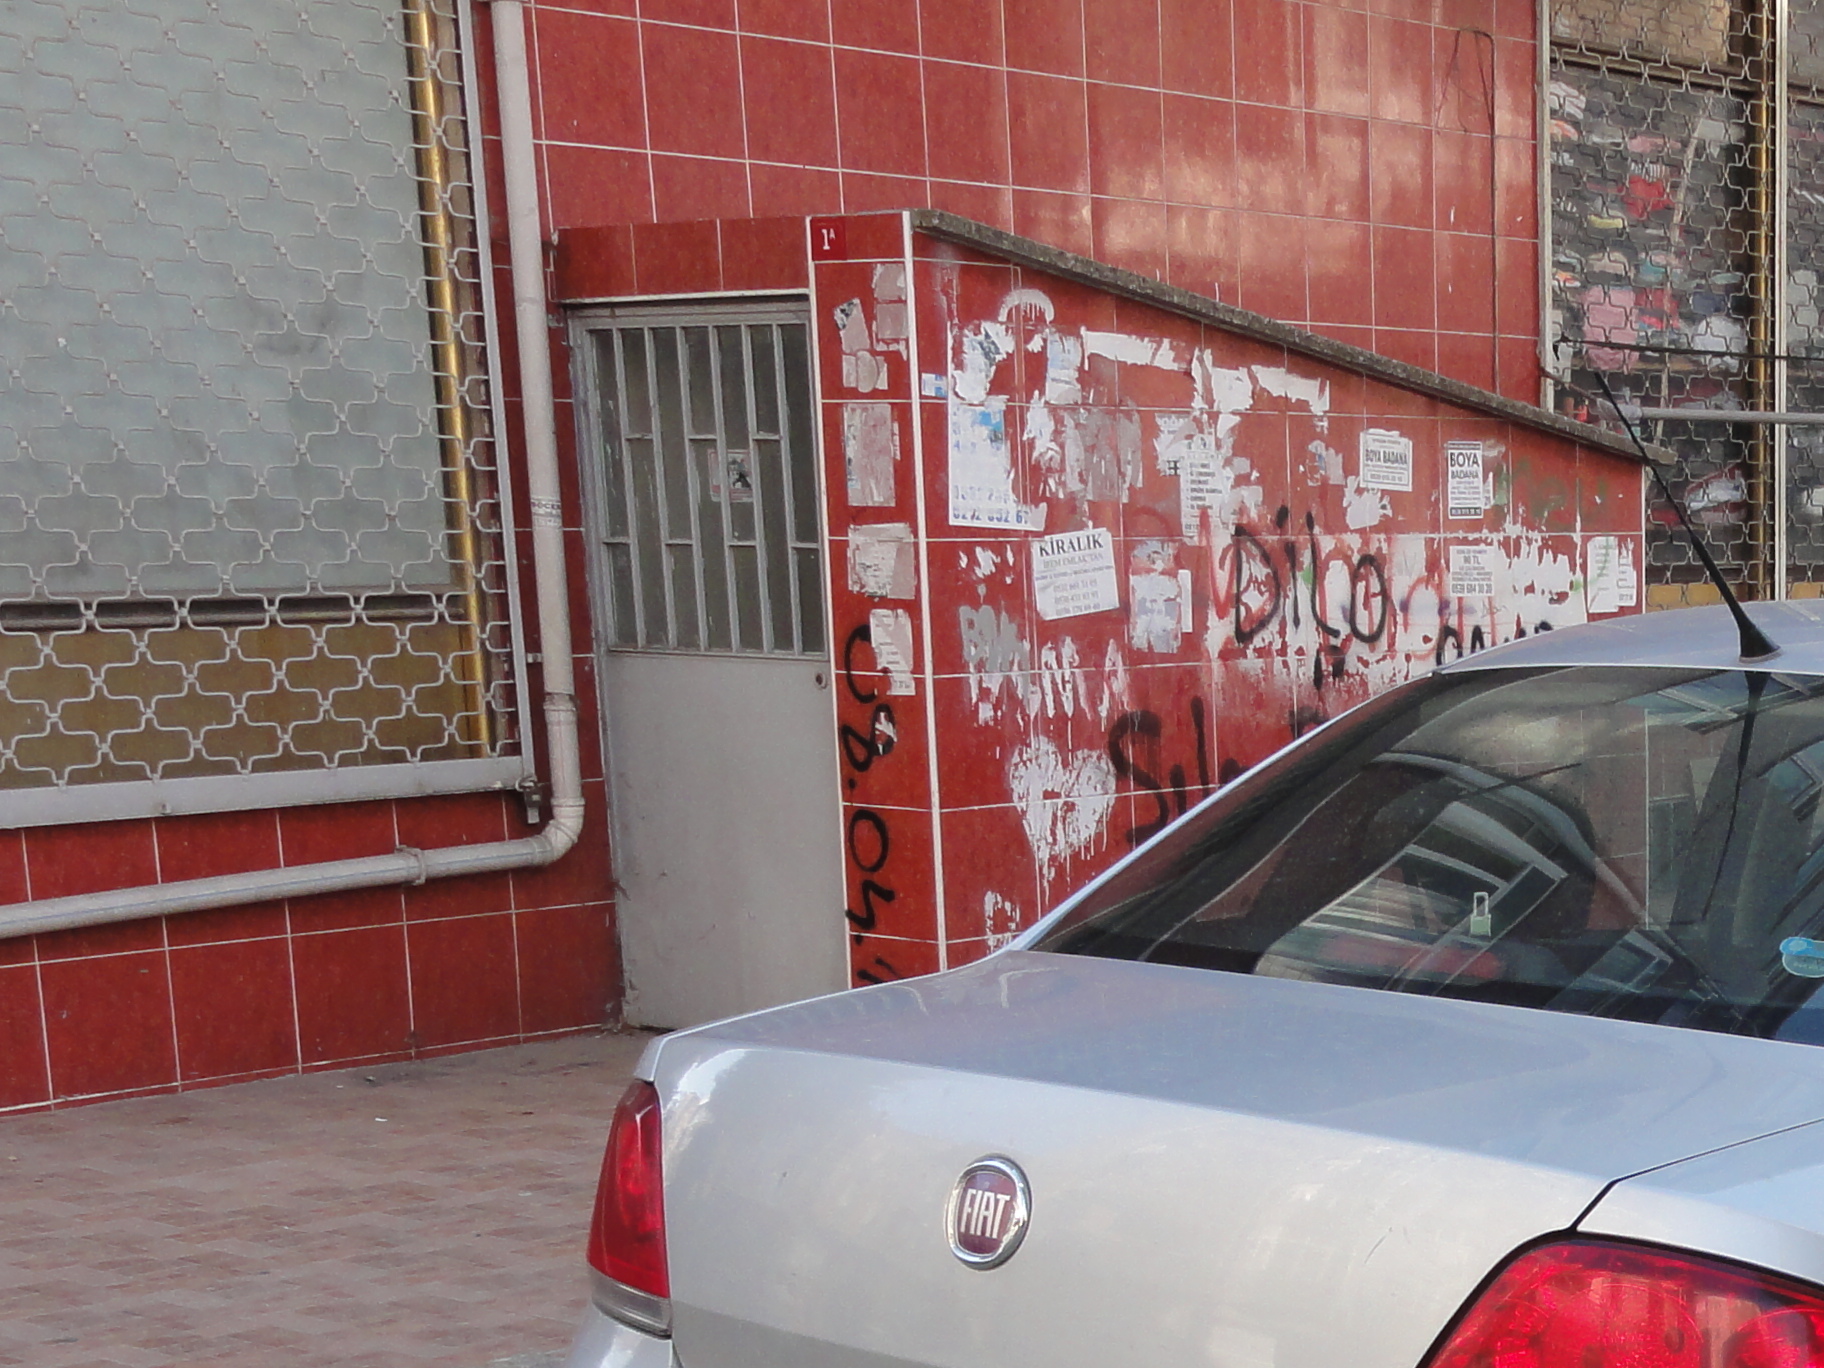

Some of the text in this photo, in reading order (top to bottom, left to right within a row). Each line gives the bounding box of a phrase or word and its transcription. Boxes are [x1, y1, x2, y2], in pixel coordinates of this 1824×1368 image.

[821, 228, 836, 250] 1A
[1449, 452, 1480, 468] BOYA
[1040, 533, 1104, 558] KİRALIK
[960, 1188, 1011, 1239] FIAT
